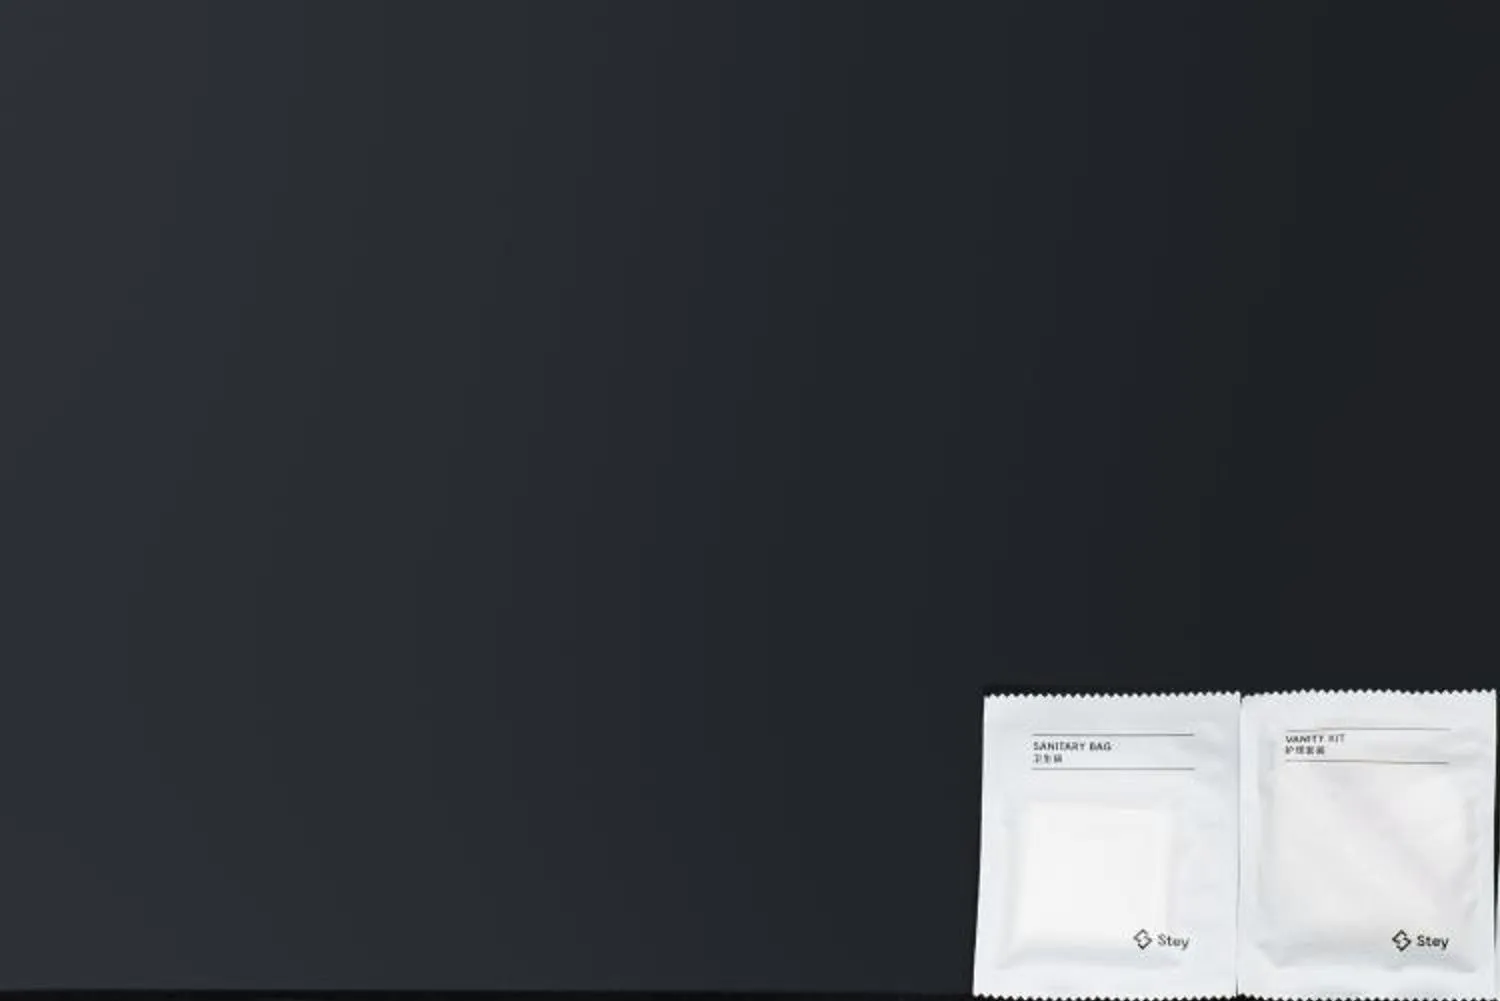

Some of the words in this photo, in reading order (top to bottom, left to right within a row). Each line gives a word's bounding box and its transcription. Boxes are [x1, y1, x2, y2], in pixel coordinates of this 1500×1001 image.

[1285, 735, 1324, 743] VANITY
[1033, 741, 1085, 751] SANITARY
[1089, 741, 1112, 751] BAG
